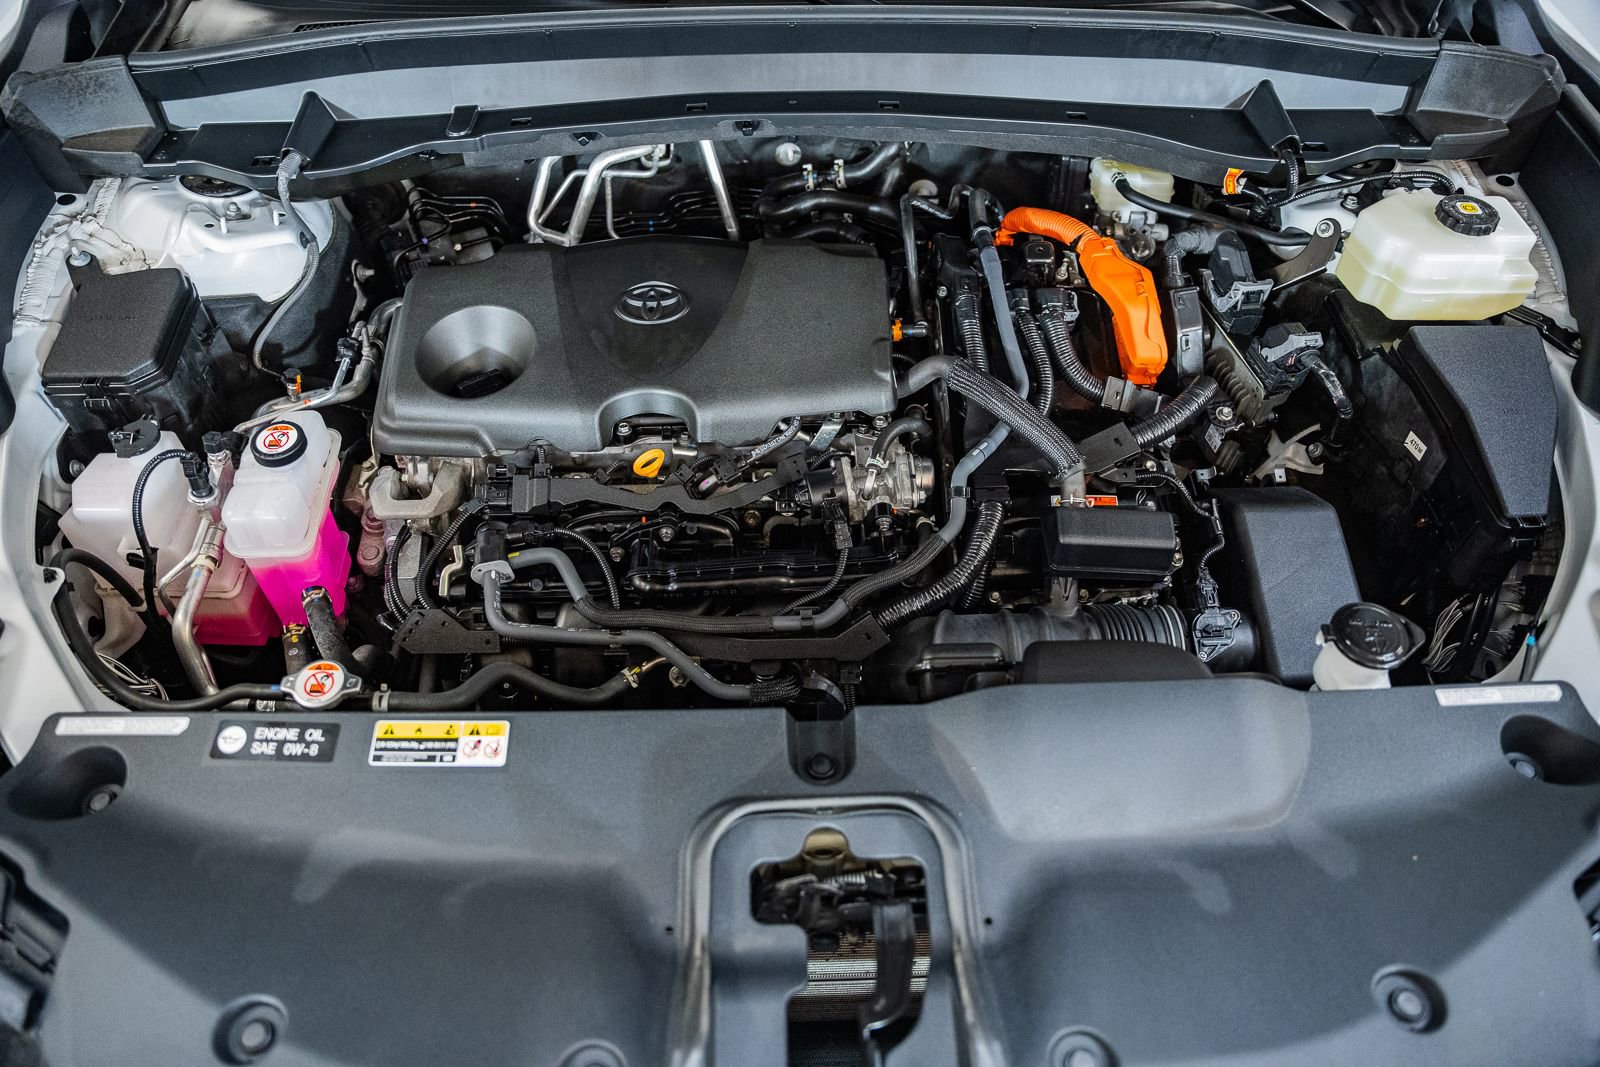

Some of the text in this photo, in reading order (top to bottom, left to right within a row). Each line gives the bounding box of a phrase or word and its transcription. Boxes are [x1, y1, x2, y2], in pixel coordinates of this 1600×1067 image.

[254, 727, 326, 742] ENGINE OIL
[250, 741, 319, 757] SAE 0W-8
